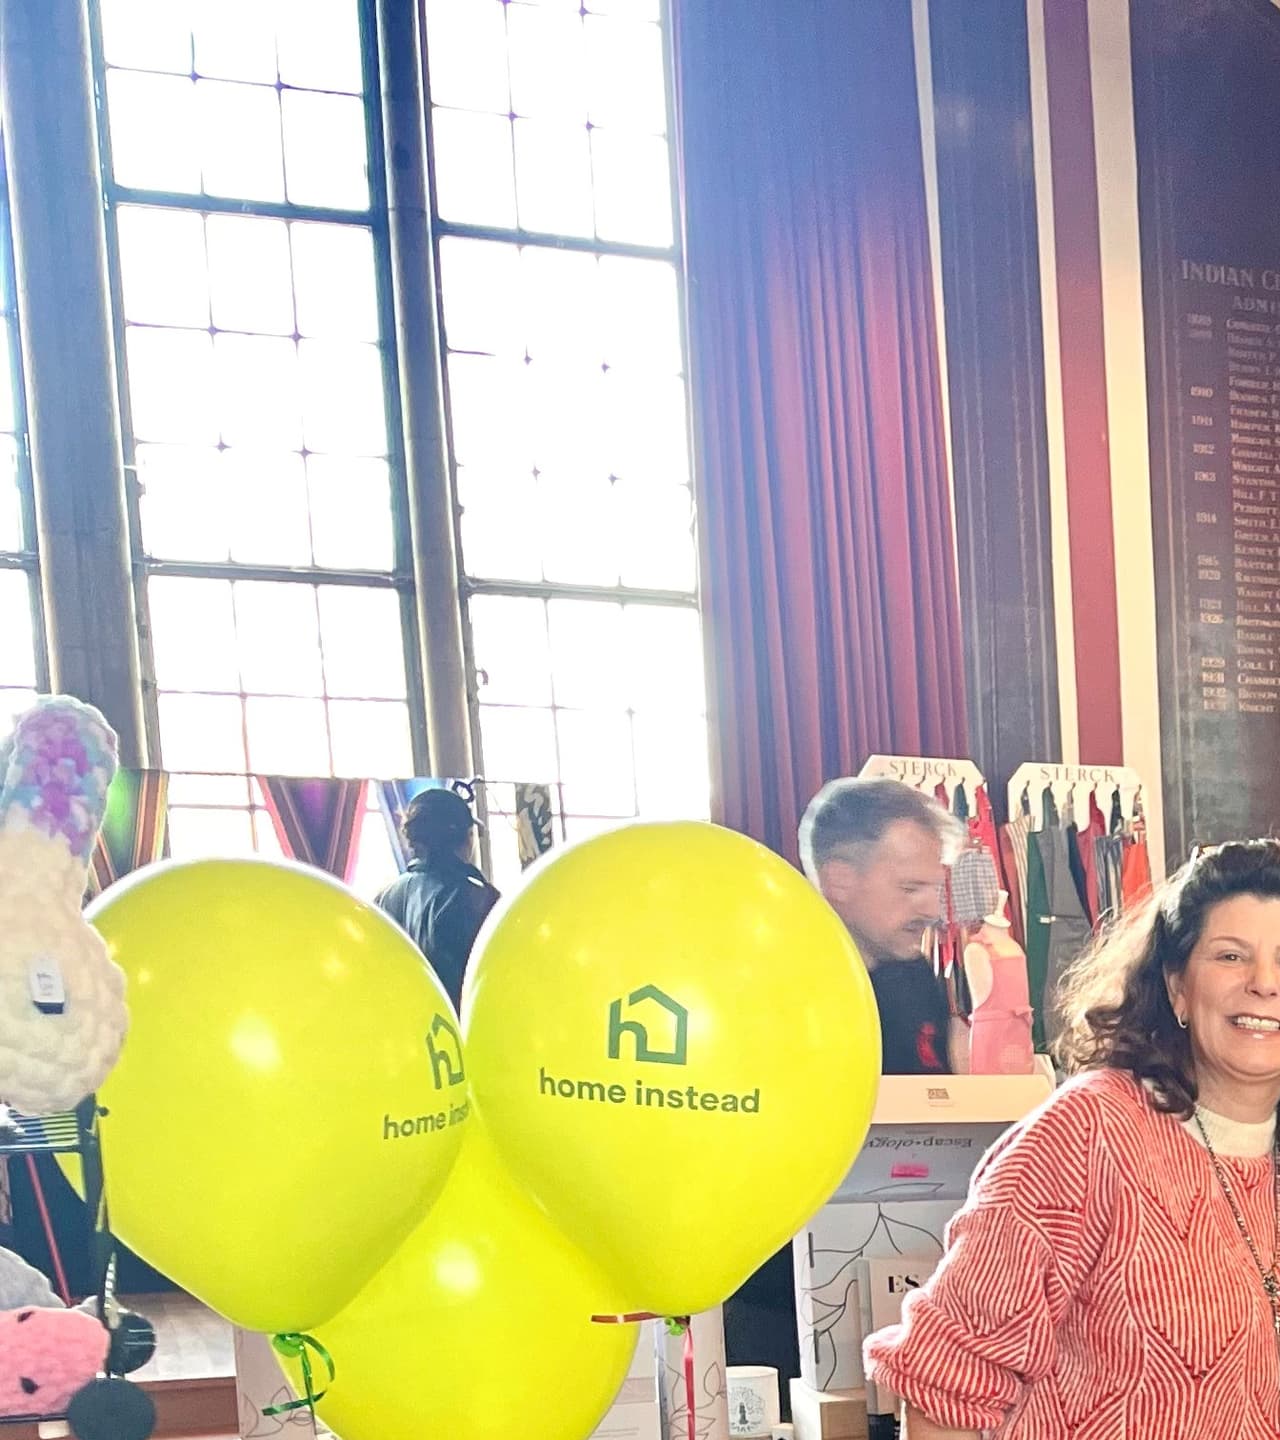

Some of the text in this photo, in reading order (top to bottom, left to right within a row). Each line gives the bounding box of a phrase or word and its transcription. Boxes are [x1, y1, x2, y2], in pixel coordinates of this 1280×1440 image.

[1182, 259, 1254, 288] INDIAN
[889, 760, 957, 777] STERCK
[1040, 766, 1115, 783] STERCK
[539, 1067, 760, 1114] home instead
[383, 1111, 446, 1141] home
